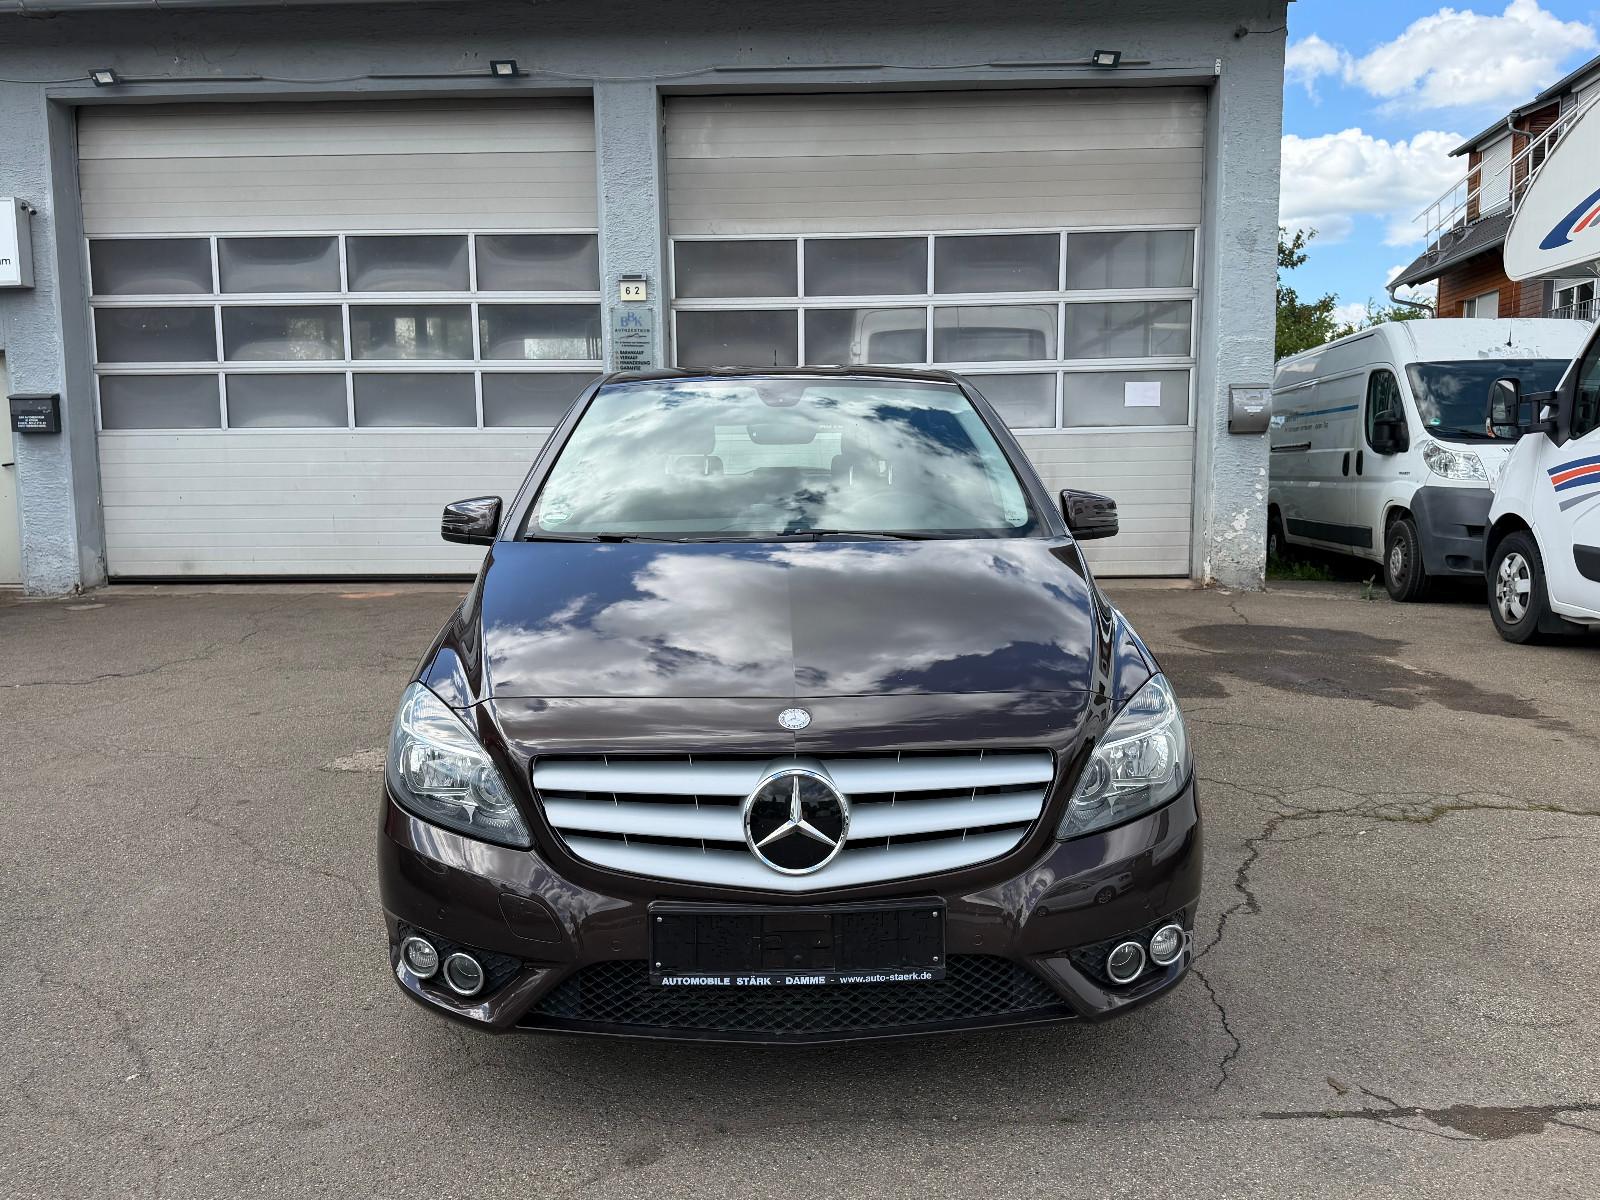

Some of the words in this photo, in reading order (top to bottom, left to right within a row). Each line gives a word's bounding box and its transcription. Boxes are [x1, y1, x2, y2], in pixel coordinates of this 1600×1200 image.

[620, 311, 642, 327] BBK
[661, 976, 731, 986] AUTOMOBILE
[736, 975, 772, 986] STÄRK
[785, 976, 826, 985] DAMME
[839, 971, 932, 985] www.auto-staerk.de
